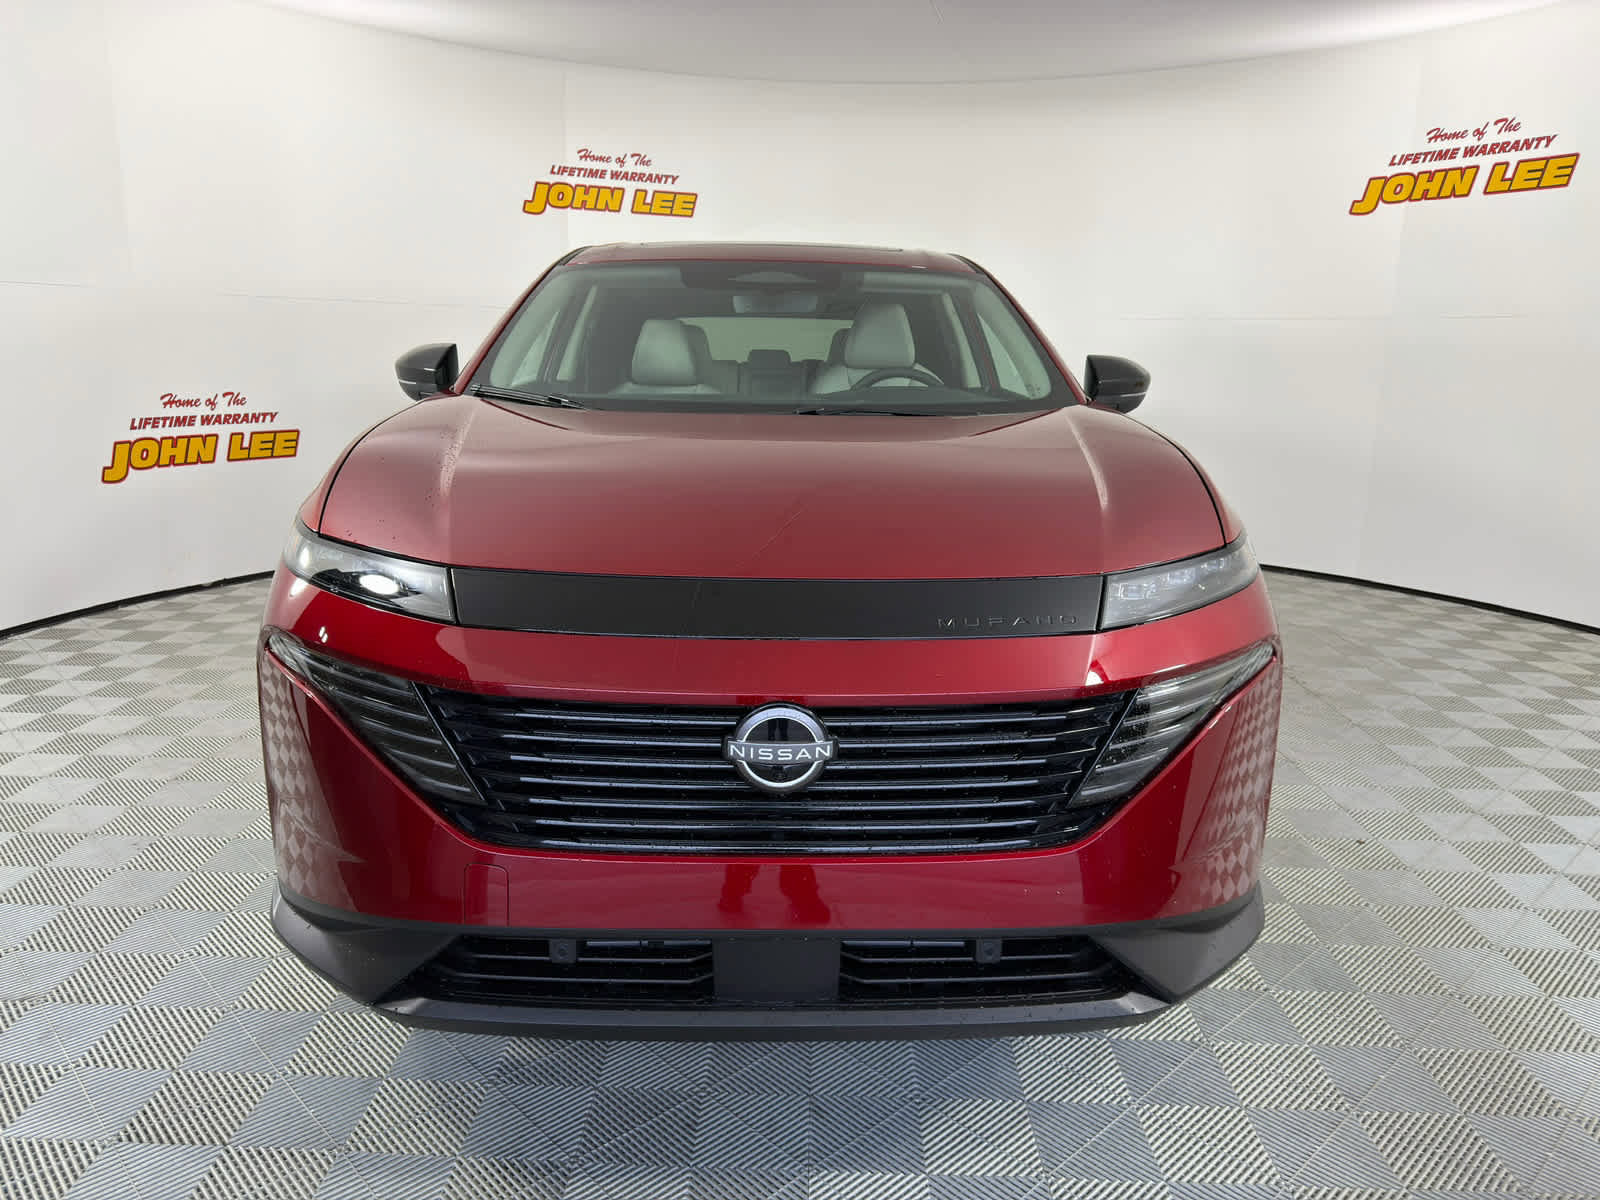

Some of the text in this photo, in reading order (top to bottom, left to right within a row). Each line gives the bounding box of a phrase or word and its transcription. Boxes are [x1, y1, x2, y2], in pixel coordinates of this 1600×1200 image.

[1426, 117, 1521, 143] Home of The
[577, 148, 652, 167] Home of The
[1388, 134, 1557, 167] LIFETIME WARRANTY
[550, 165, 680, 185] LIFETIME WARRANTY
[1349, 152, 1580, 216] JOHN LEE
[523, 181, 698, 218] JOHN LEE
[160, 391, 247, 411] Home of The
[129, 411, 279, 431] LIFETIME WARRANTY
[101, 429, 300, 484] JOHN LEE
[729, 744, 831, 761] NISSAN
